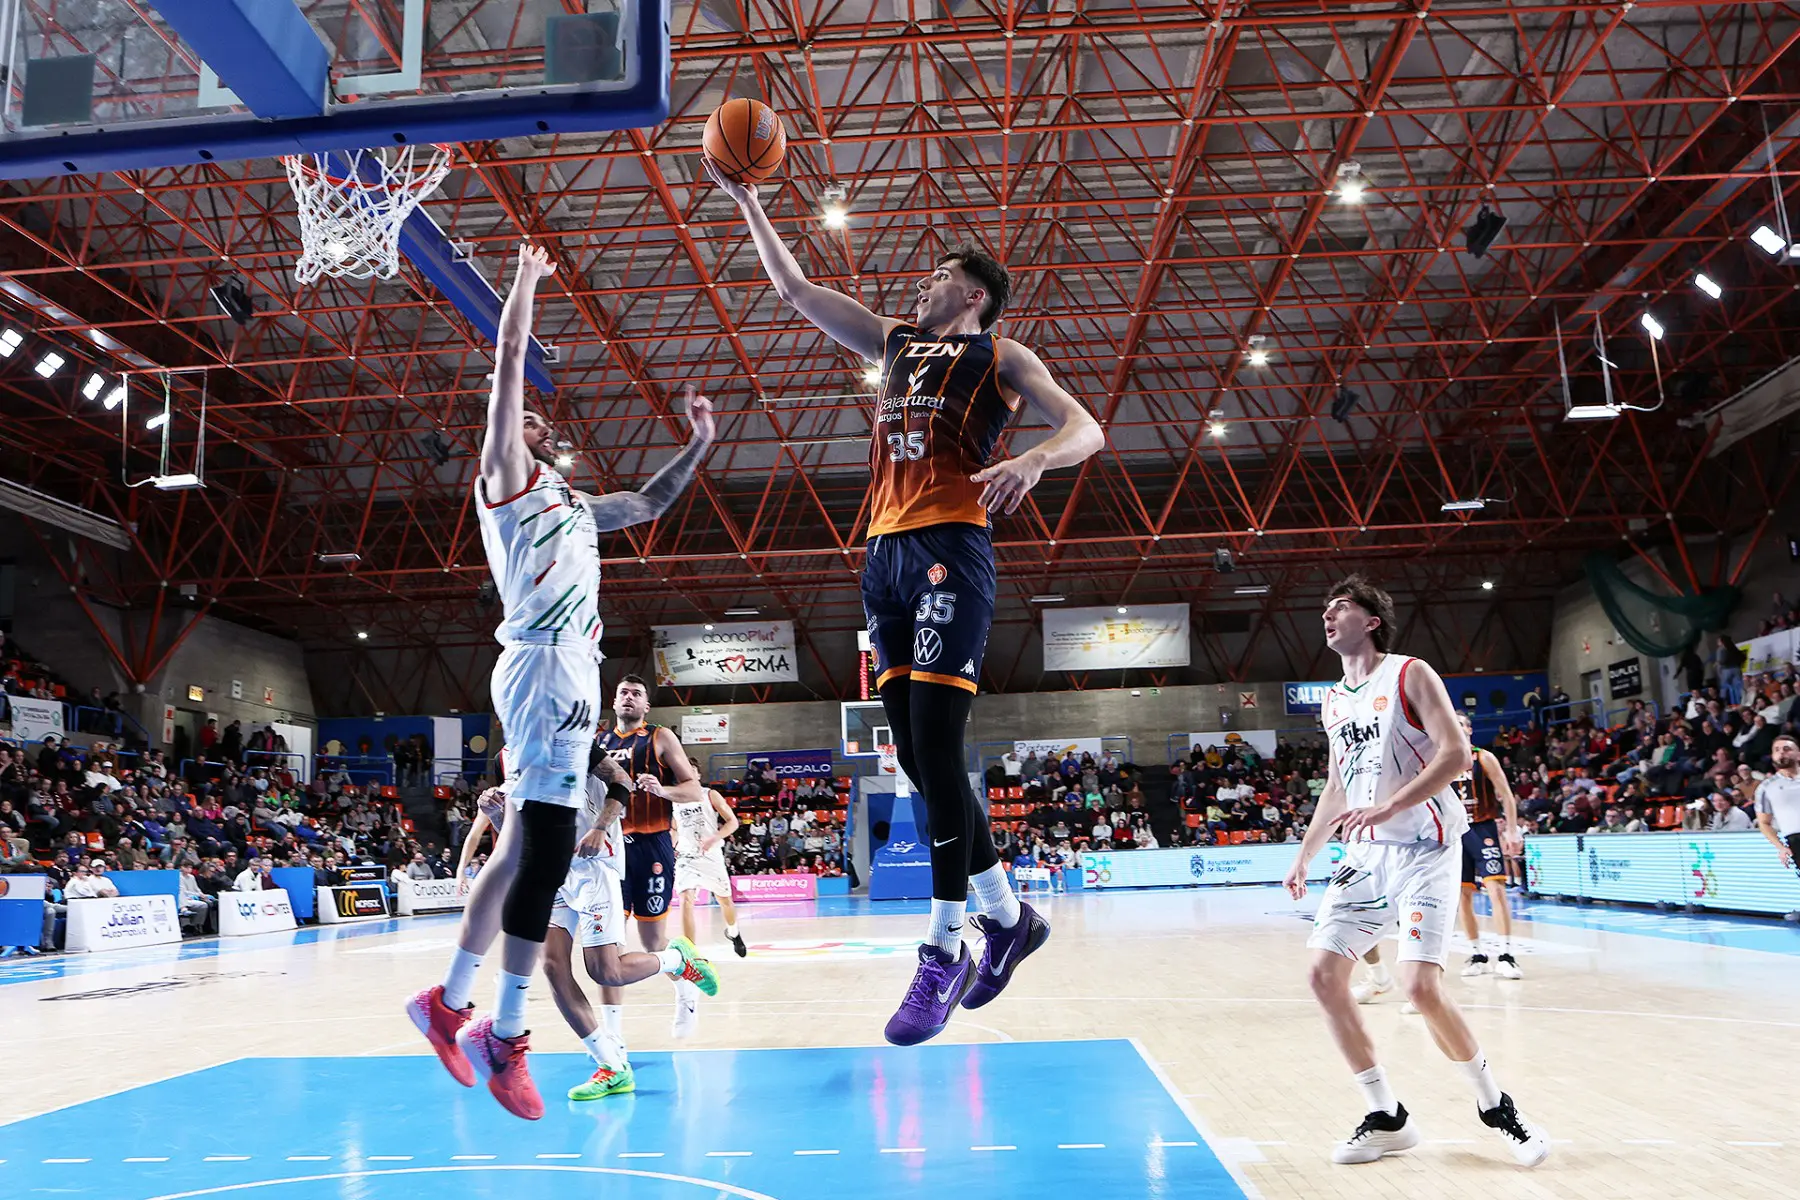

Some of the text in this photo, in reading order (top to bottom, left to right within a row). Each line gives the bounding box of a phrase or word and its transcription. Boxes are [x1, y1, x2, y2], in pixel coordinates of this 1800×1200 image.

[887, 431, 925, 462] 35
[916, 591, 957, 624] 35
[1287, 686, 1331, 704] SALID
[774, 763, 831, 774] GOZALO
[1481, 847, 1501, 860] 55
[648, 876, 665, 893] 13
